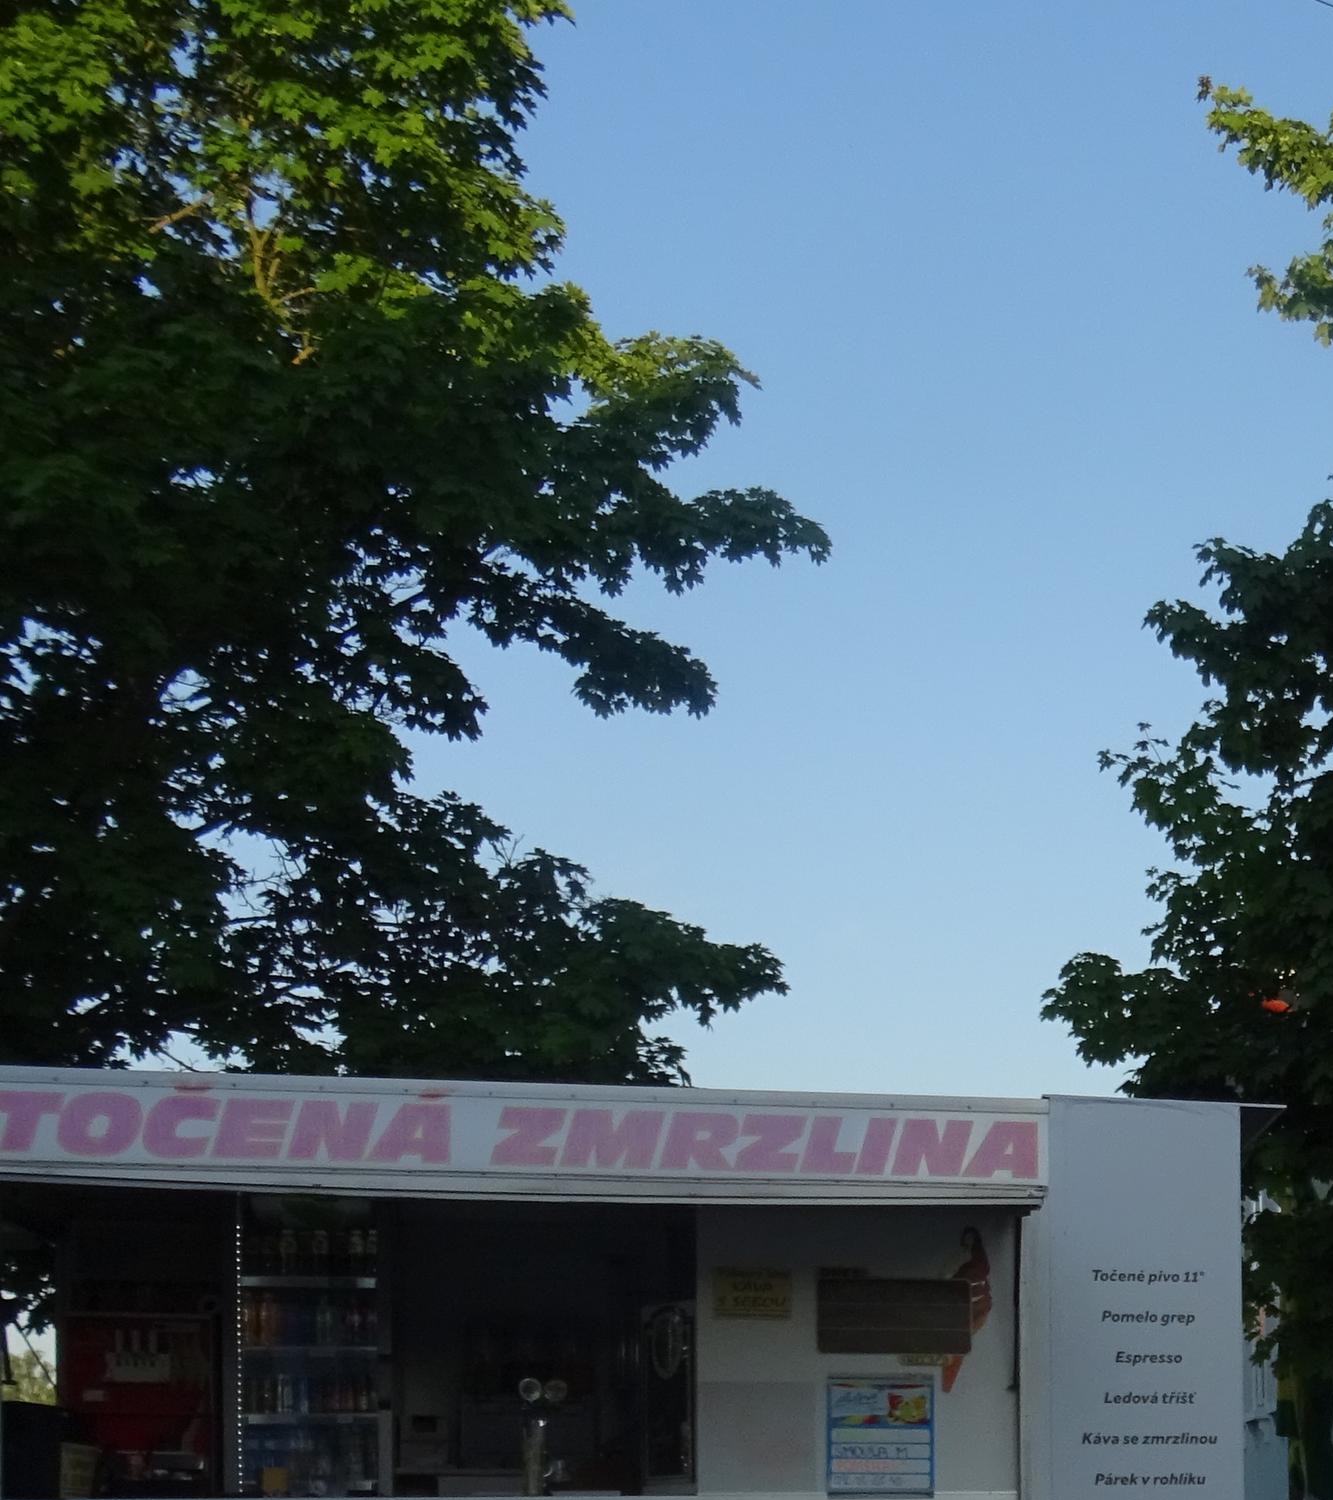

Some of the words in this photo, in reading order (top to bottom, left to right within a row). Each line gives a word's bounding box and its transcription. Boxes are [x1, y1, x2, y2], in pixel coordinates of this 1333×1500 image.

[0, 1081, 451, 1164] TOČENÁ
[490, 1106, 1039, 1179] ZMRZLINA
[1092, 1269, 1145, 1282] Točené
[1148, 1270, 1180, 1285] pivo
[1102, 1310, 1158, 1323] Pomelo
[1160, 1313, 1195, 1326] grep
[1115, 1351, 1183, 1366] Espresso
[1104, 1391, 1159, 1404] Ledová
[1162, 1391, 1197, 1404] tříšť
[1081, 1432, 1120, 1445] Káva
[1123, 1435, 1139, 1445] se
[1141, 1432, 1218, 1445] zmrzlinou
[1095, 1472, 1138, 1486] Párek
[1141, 1475, 1151, 1486] v
[1153, 1472, 1206, 1486] rohlíku
